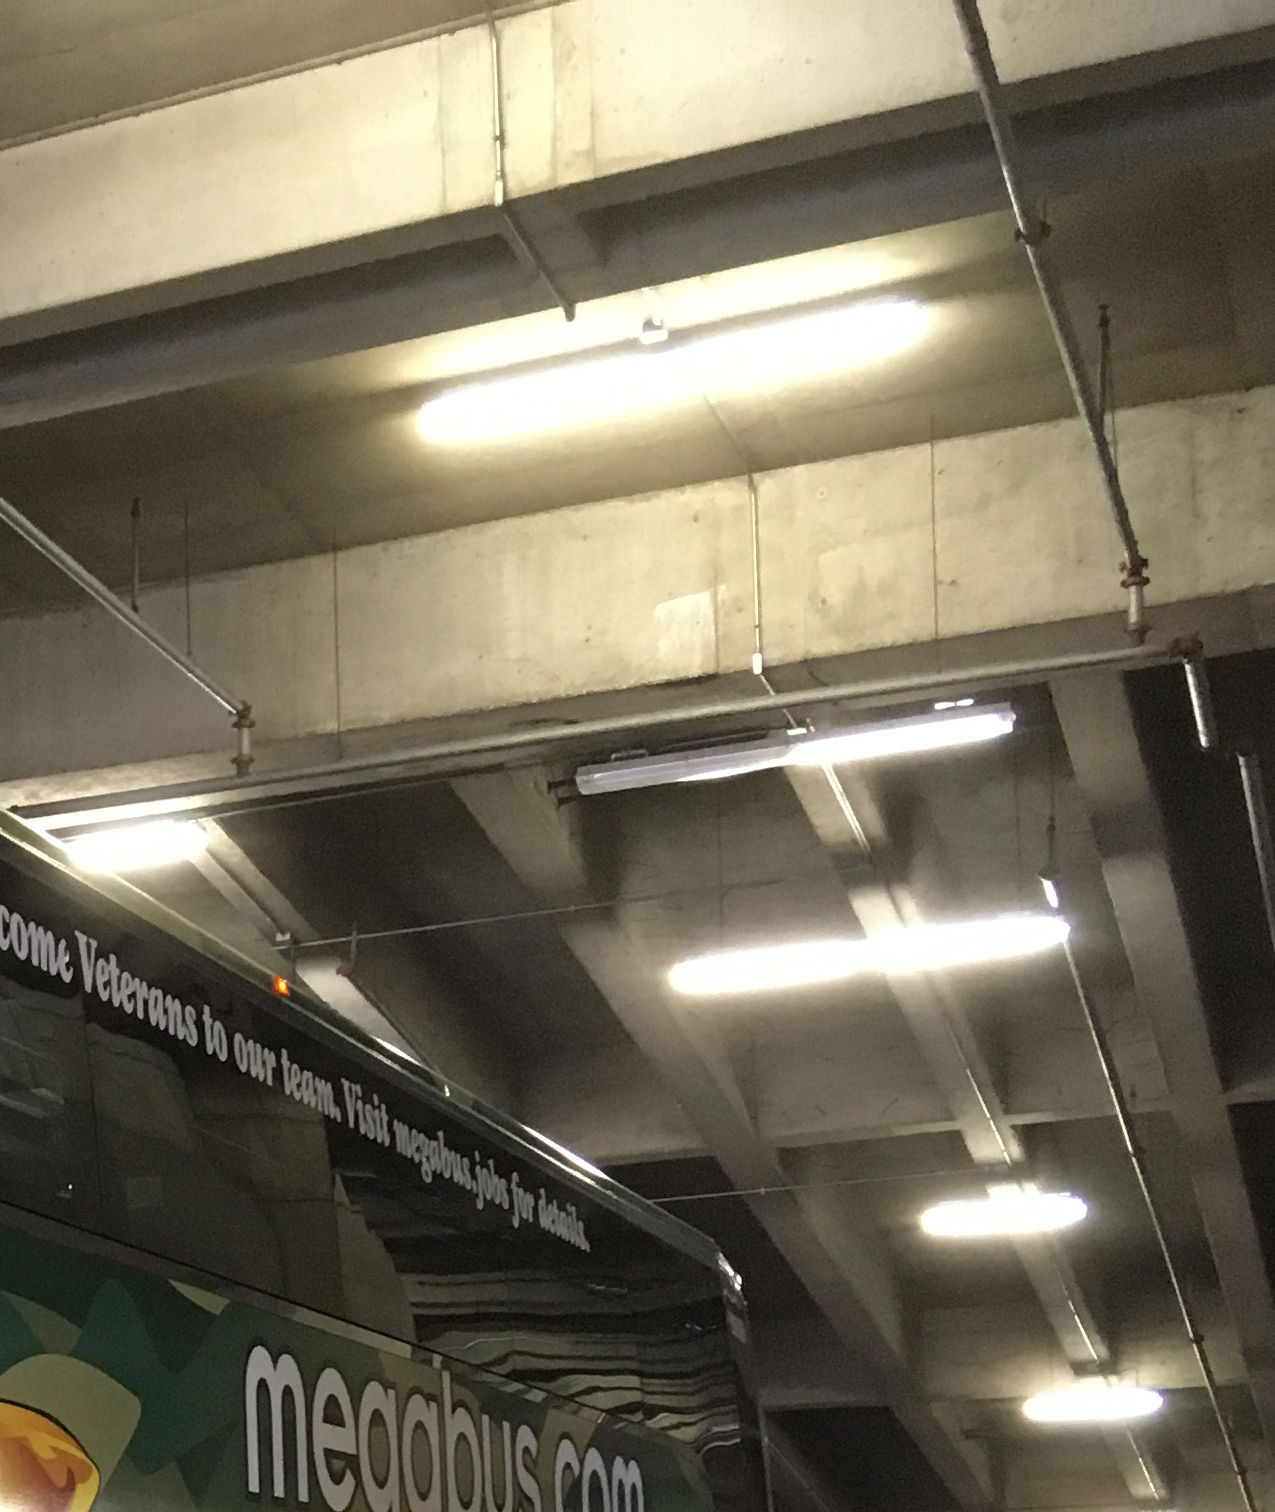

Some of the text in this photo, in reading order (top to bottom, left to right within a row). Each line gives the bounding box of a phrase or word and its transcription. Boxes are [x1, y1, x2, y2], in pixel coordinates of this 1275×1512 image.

[74, 930, 198, 1047] Veterans
[203, 1004, 228, 1062] to
[234, 1032, 276, 1087] our
[280, 1048, 341, 1123] team.
[340, 1078, 390, 1147] Visit
[392, 1117, 510, 1210] megabus.jobs
[510, 1171, 534, 1229] for
